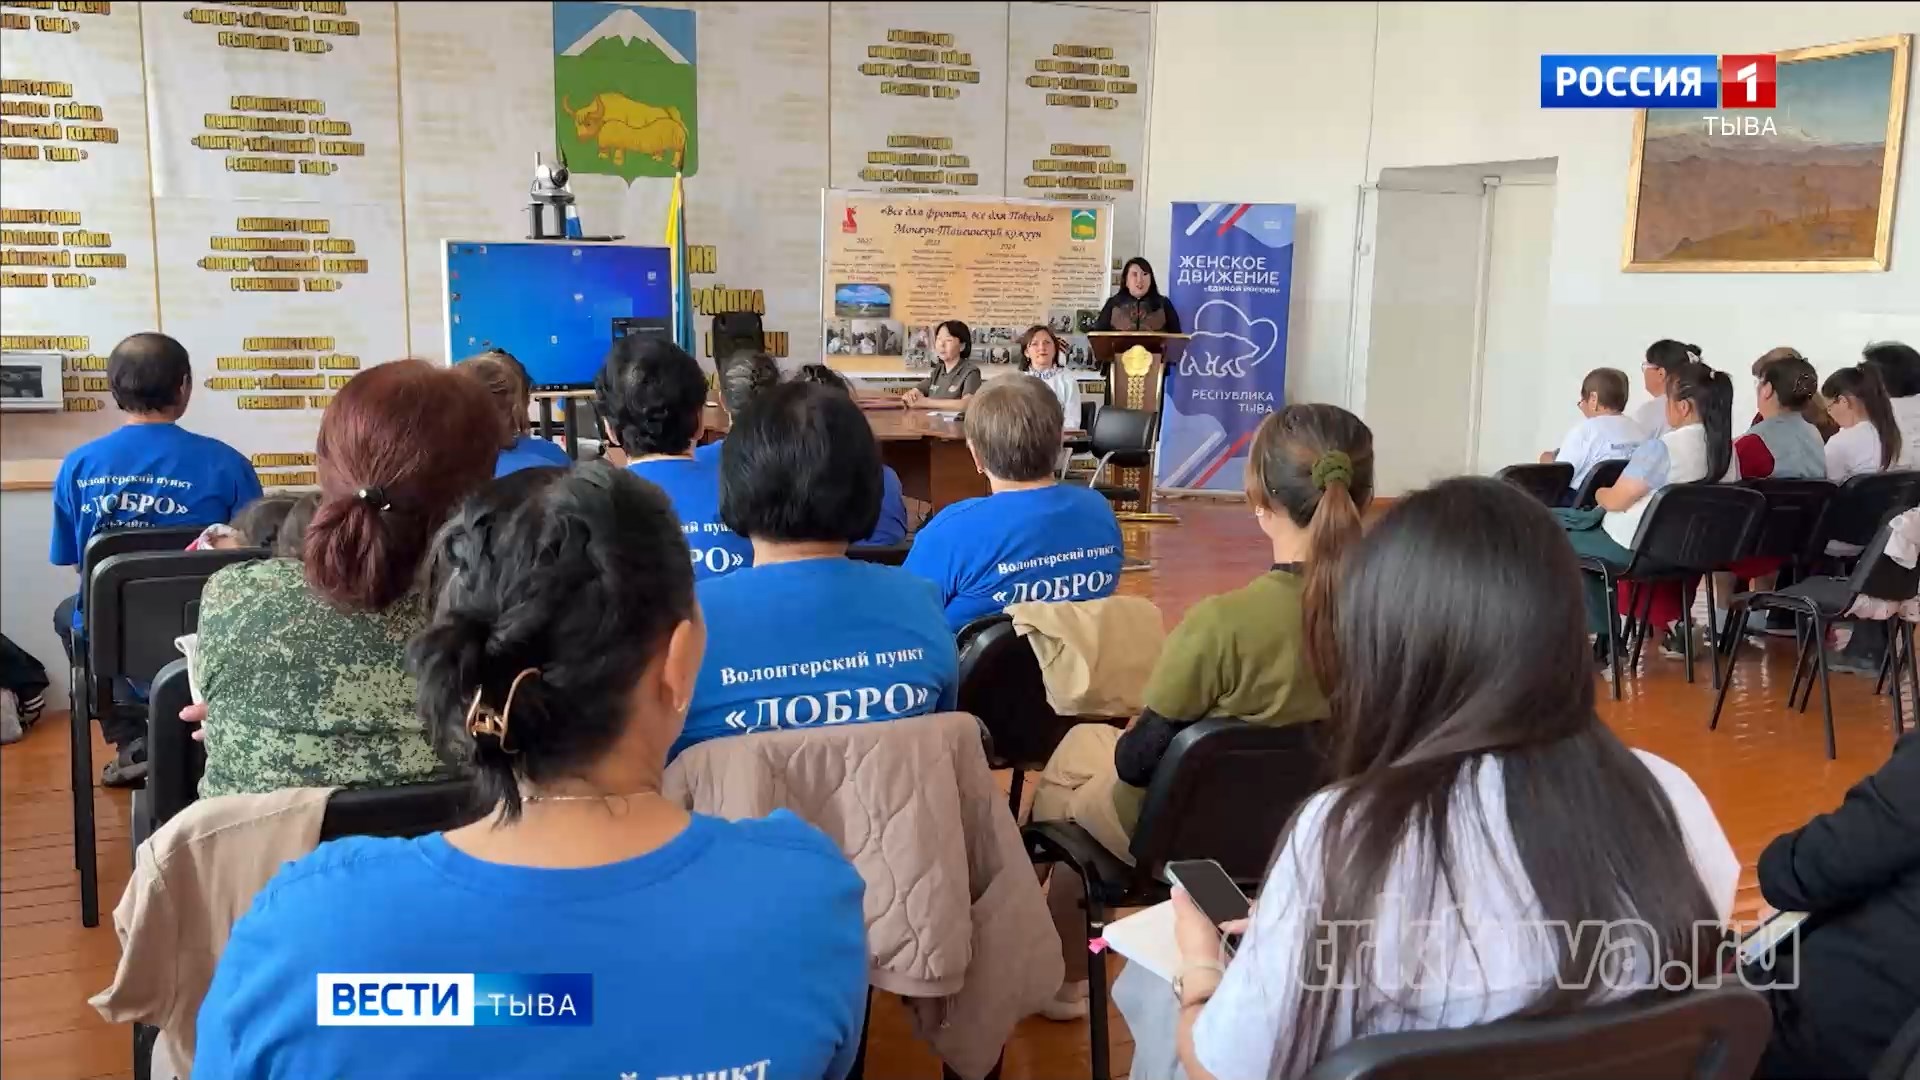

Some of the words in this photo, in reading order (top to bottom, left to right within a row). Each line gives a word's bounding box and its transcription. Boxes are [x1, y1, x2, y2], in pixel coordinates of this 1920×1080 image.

[1178, 255, 1267, 270] ЖЕНСКОЕ
[1177, 269, 1280, 286] ДВИЖЕНИЕ
[691, 284, 765, 316] РАЙОНА
[1192, 389, 1274, 401] РЕСПУБЛИКА
[1238, 403, 1273, 414] ТЫВА
[156, 476, 193, 490] пункт
[997, 548, 1084, 575] Волонтерский
[1086, 544, 1119, 560] пункт
[992, 570, 1113, 604] «ДОБРО»
[721, 651, 869, 686] Волонтерский
[875, 647, 924, 668] пункт
[725, 683, 929, 735] «ДОБРО»
